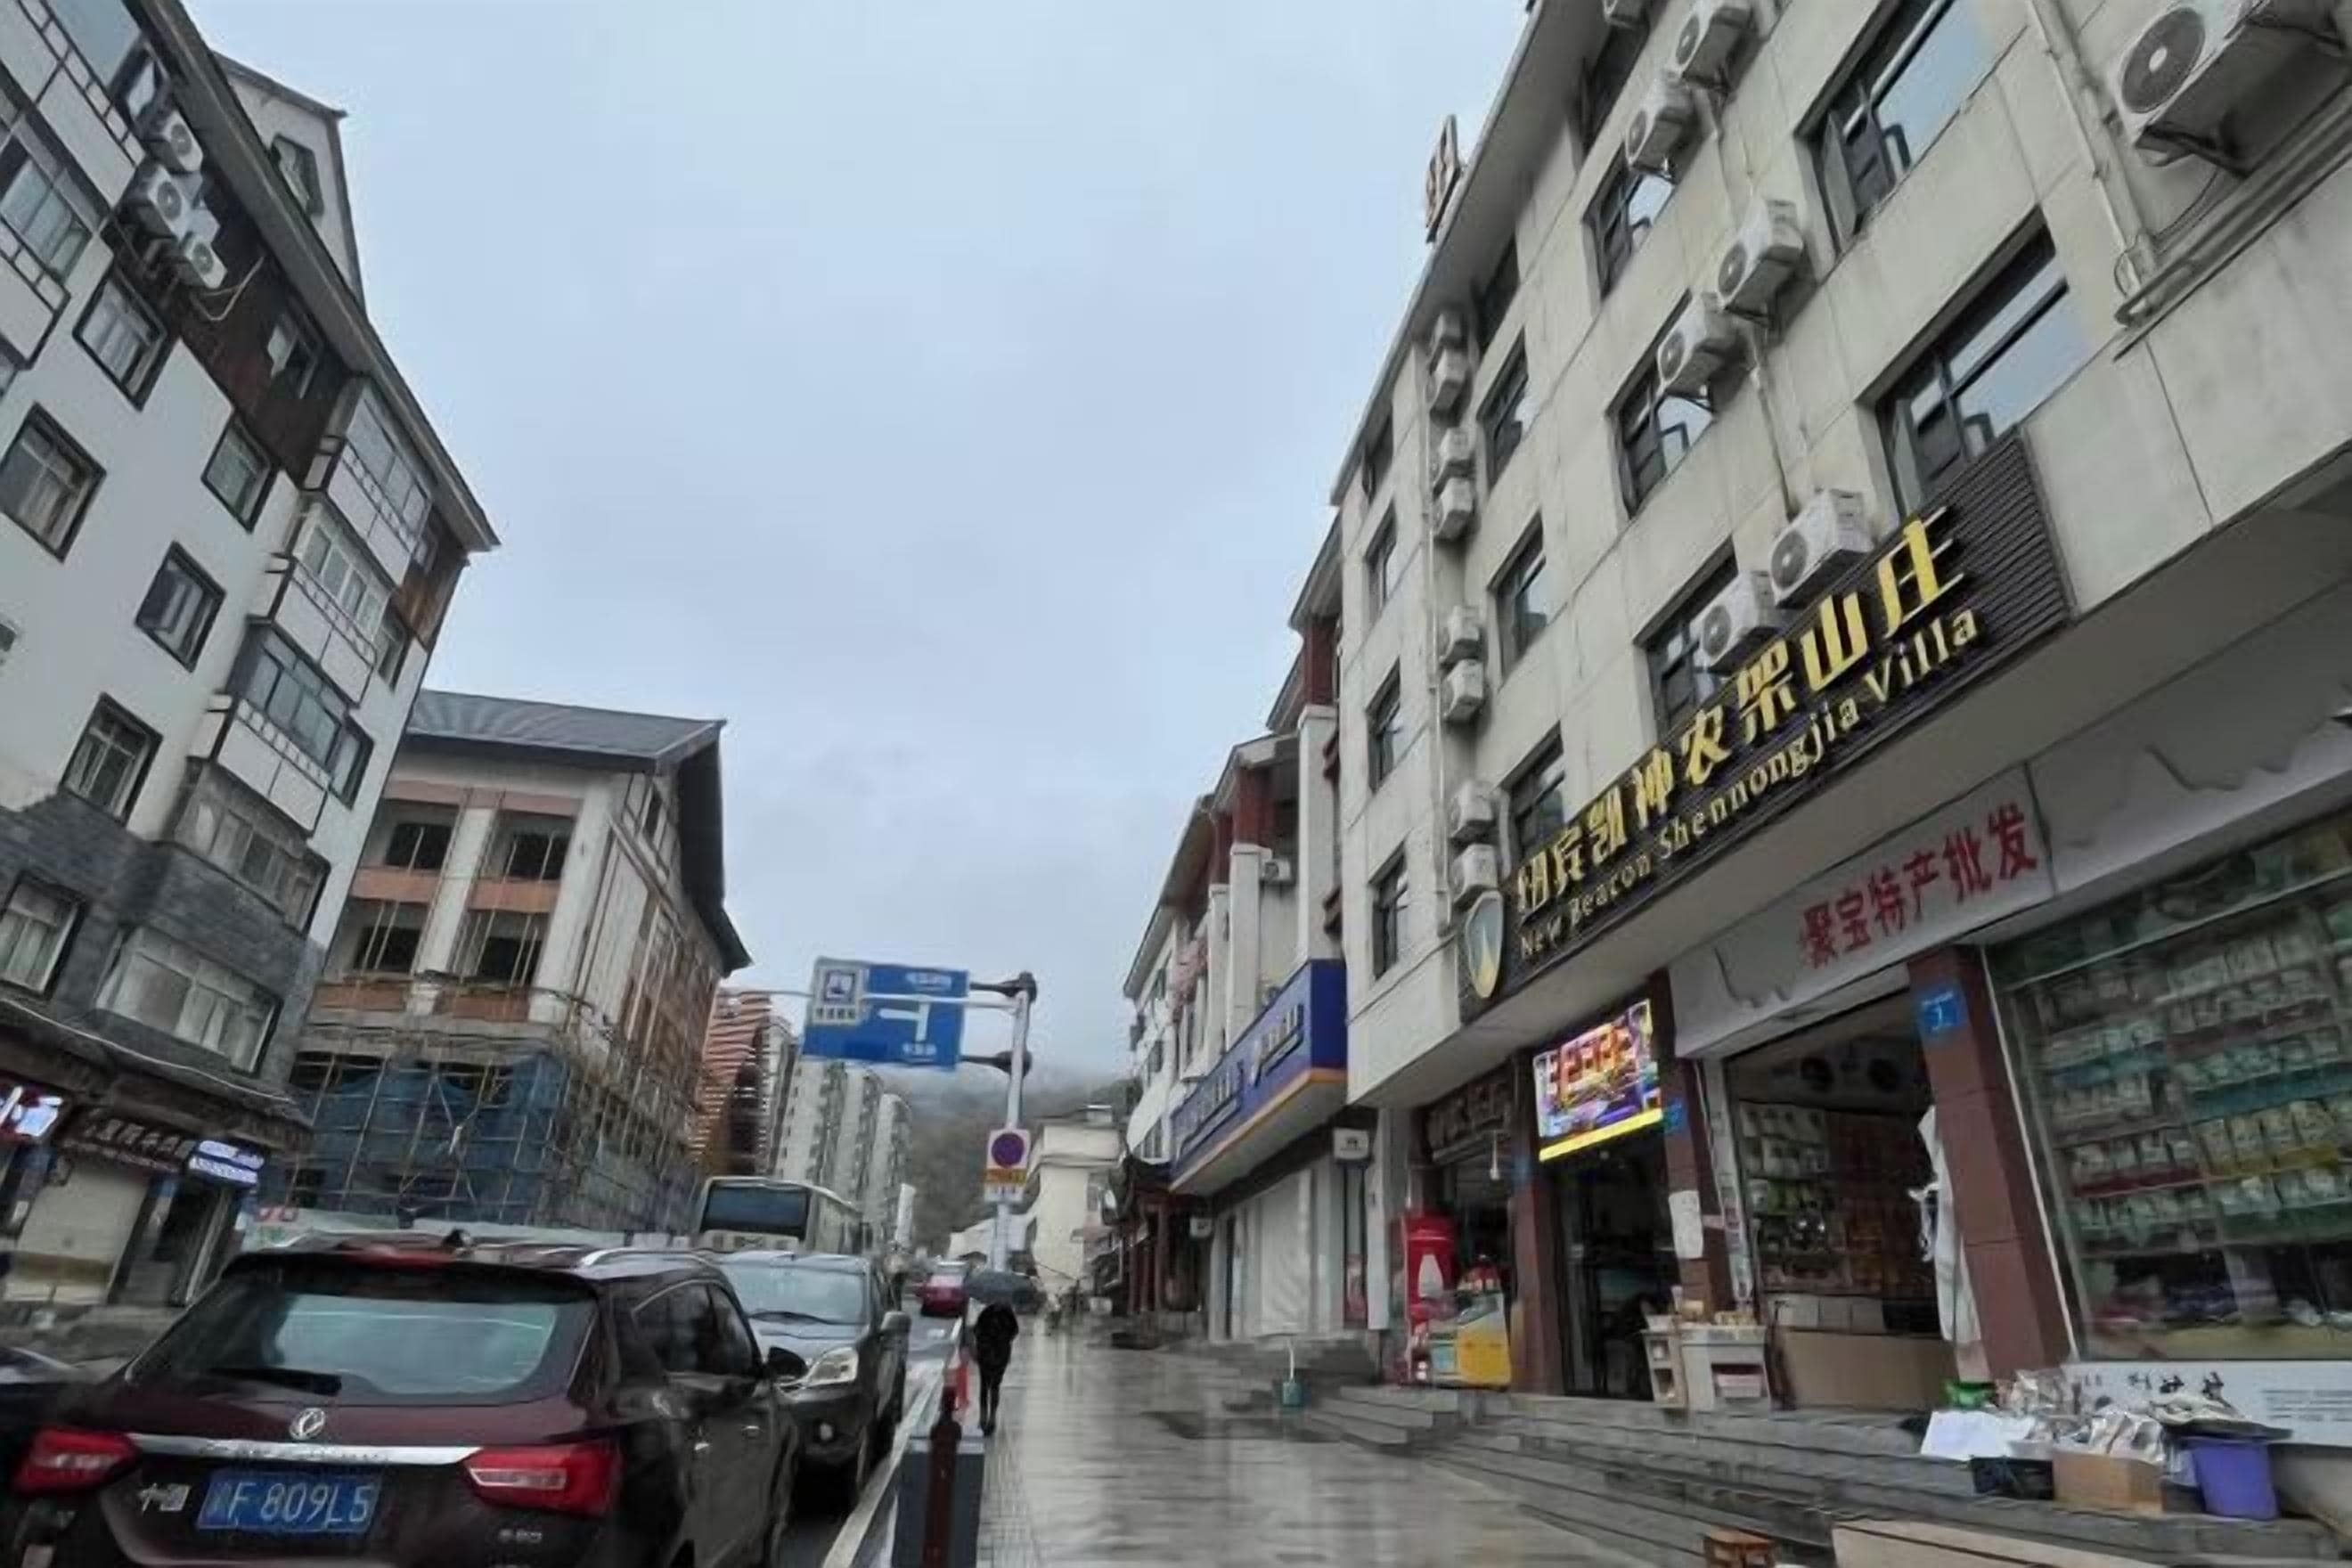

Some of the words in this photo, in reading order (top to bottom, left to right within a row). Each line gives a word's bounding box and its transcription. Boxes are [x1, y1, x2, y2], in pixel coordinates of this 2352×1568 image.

[1658, 698, 1861, 860] Shennongjia
[1863, 608, 1978, 703] Villa
[207, 1480, 373, 1524] F809L5
